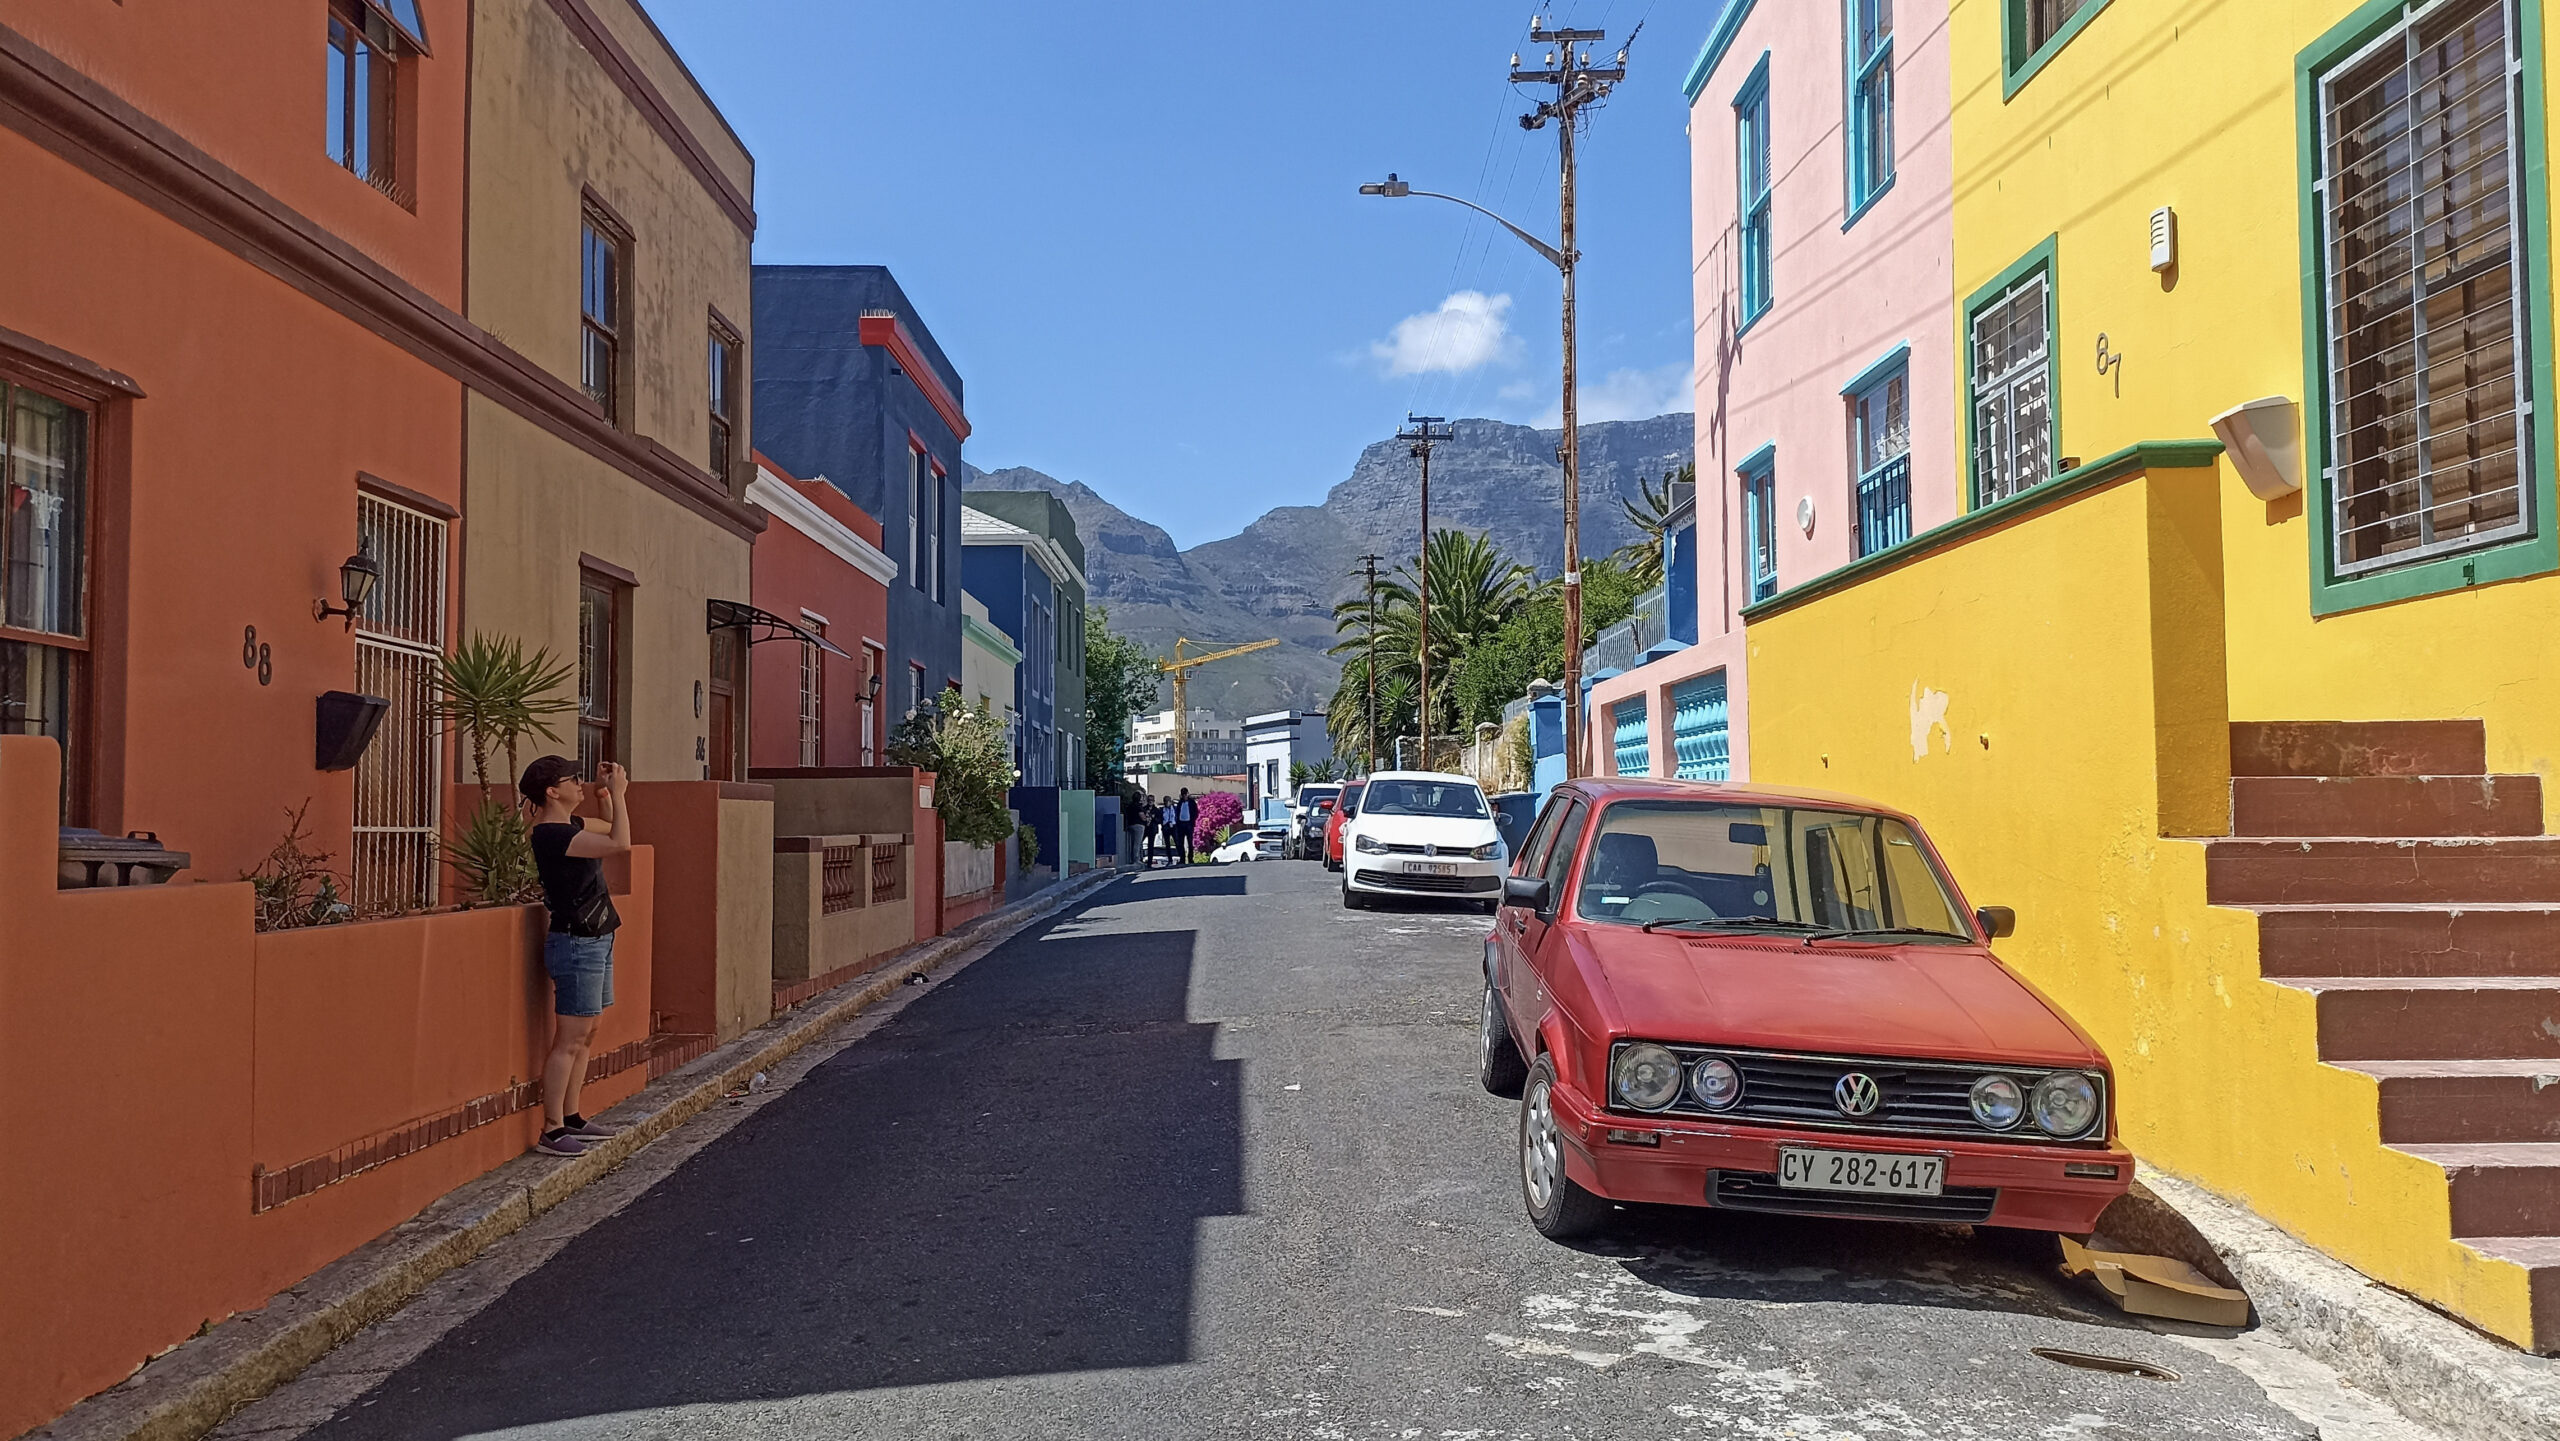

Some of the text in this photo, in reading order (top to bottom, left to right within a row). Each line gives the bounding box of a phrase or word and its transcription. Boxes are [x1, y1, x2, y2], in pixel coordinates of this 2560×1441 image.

[2096, 332, 2121, 399] 87
[243, 625, 272, 686] 88
[1407, 863, 1422, 873] CAA
[1783, 1153, 1937, 1190] CY 282-617
